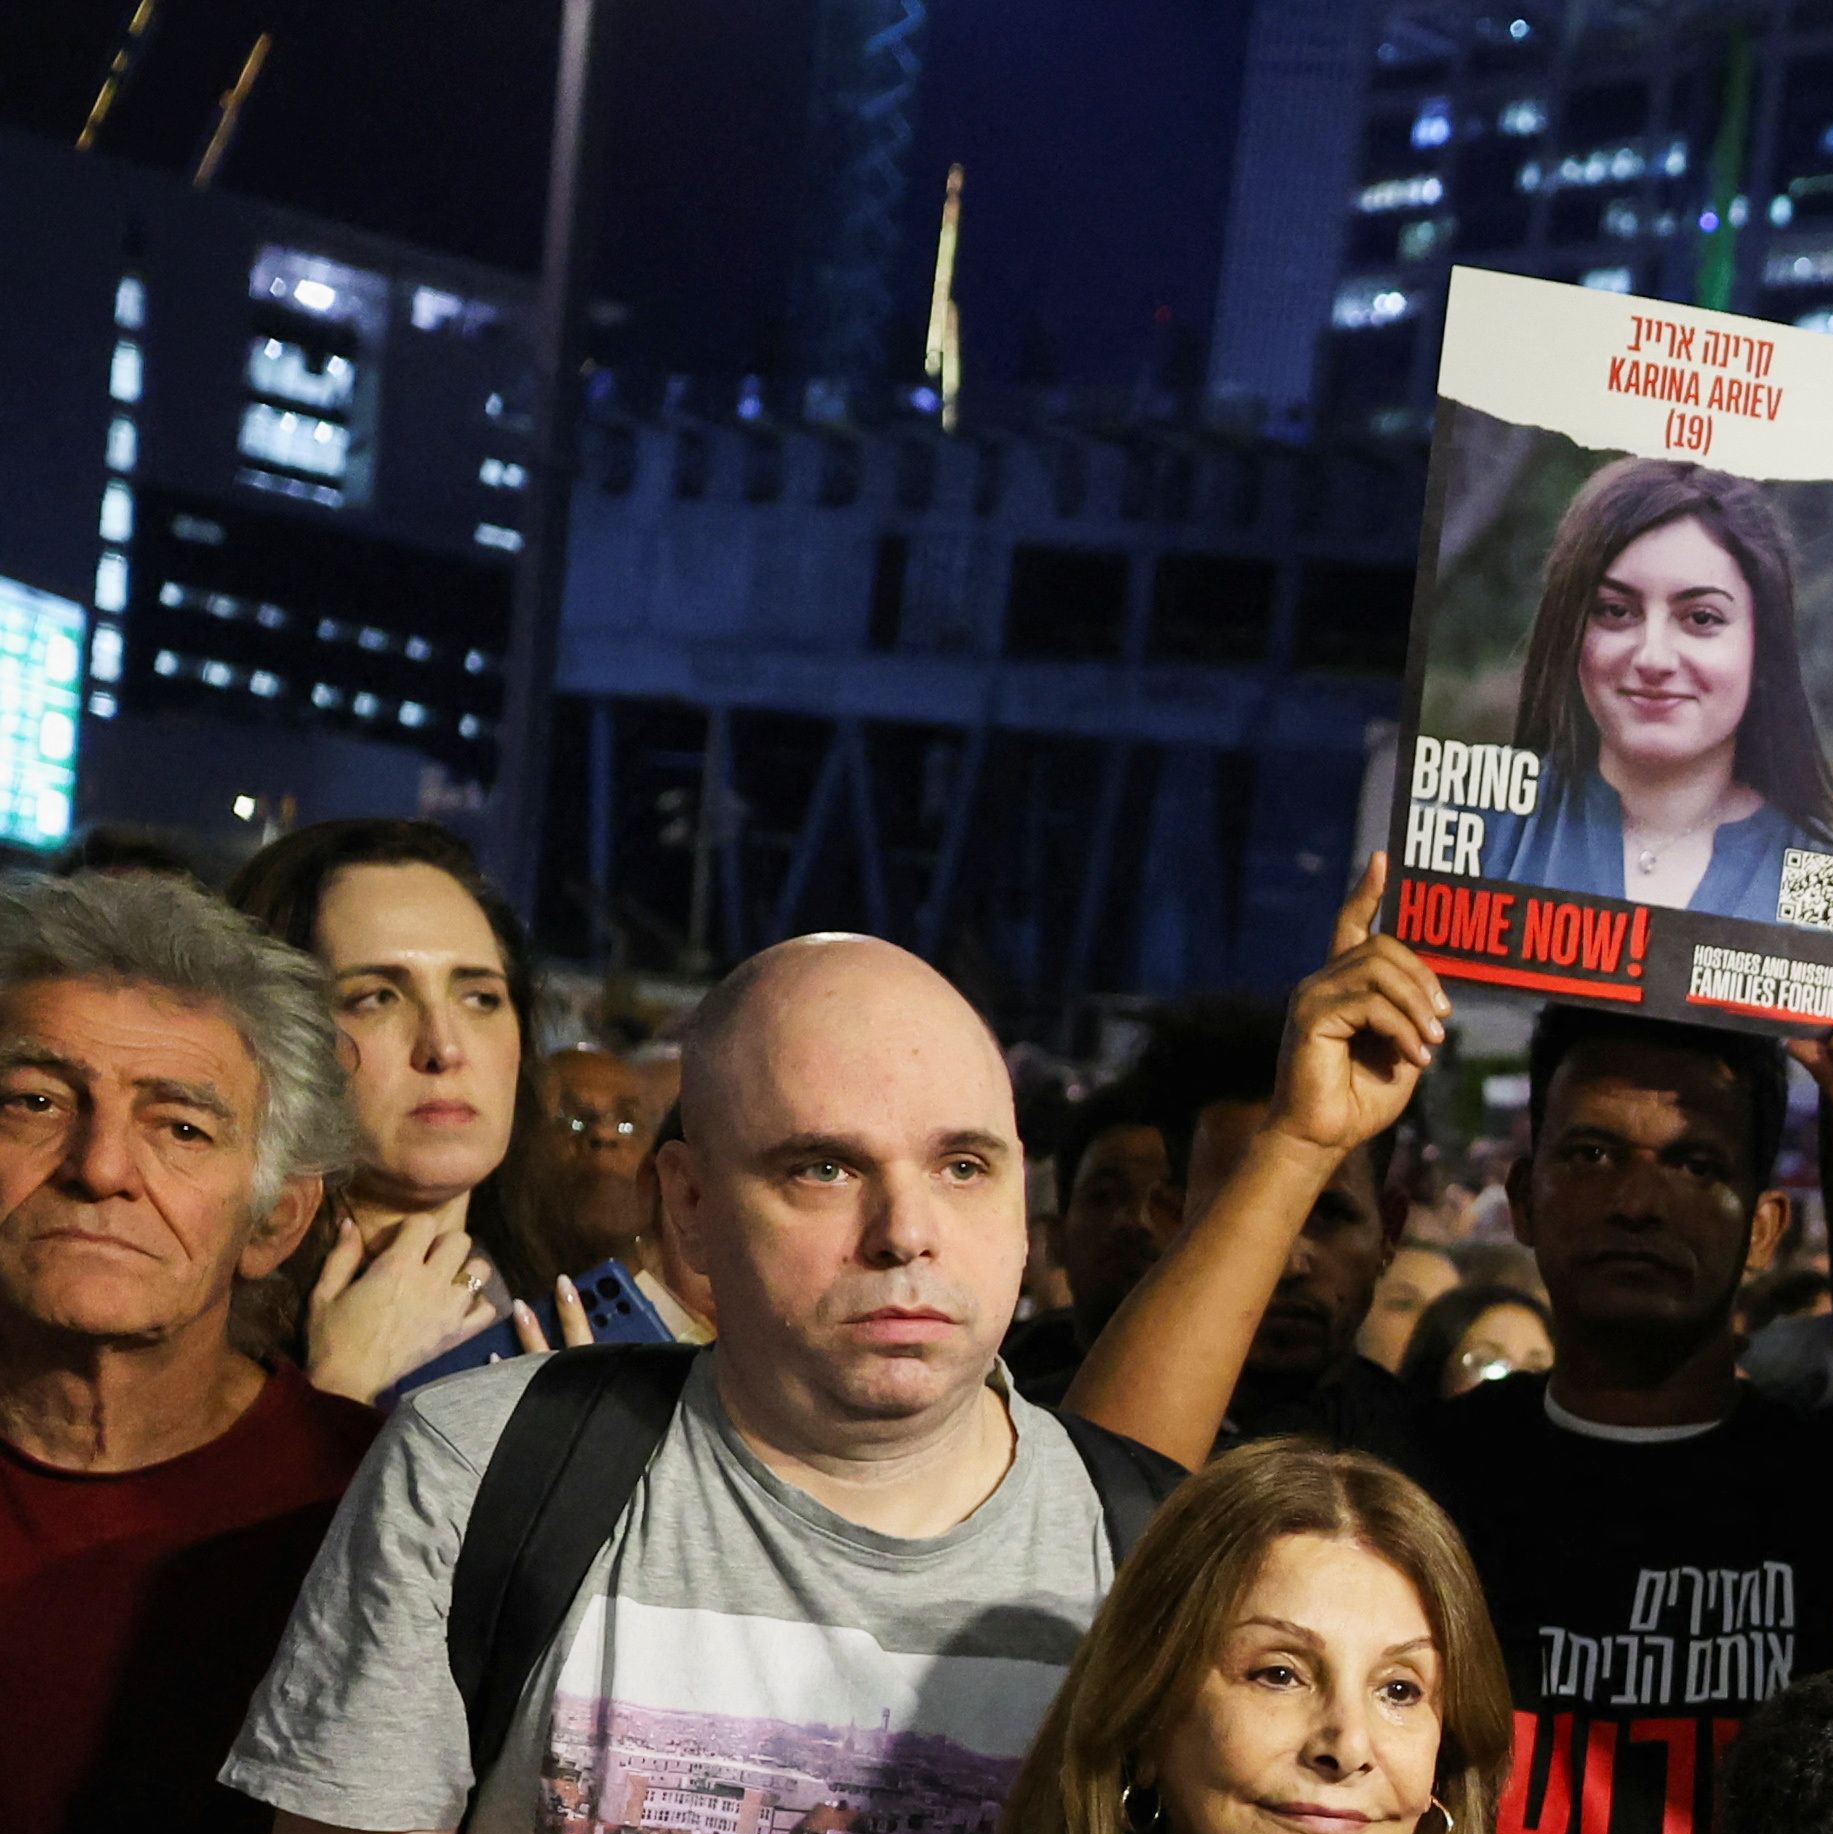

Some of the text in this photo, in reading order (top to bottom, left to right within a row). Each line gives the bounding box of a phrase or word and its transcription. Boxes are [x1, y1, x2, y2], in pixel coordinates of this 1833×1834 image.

[1627, 315, 1775, 379] קרינה ארייב
[1608, 355, 1783, 422] KARINA ARIEV
[1666, 408, 1713, 456] (19)
[1411, 735, 1540, 816] BRING
[1404, 803, 1485, 878] HER
[1396, 879, 1651, 978] HOME NOW!
[1693, 944, 1762, 976] HOSTAGES
[1761, 955, 1790, 981] AND
[1689, 965, 1777, 1009] FAMILIES
[1630, 1560, 1795, 1633] מחזירים
[1539, 1625, 1795, 1706] אותם הביתה
